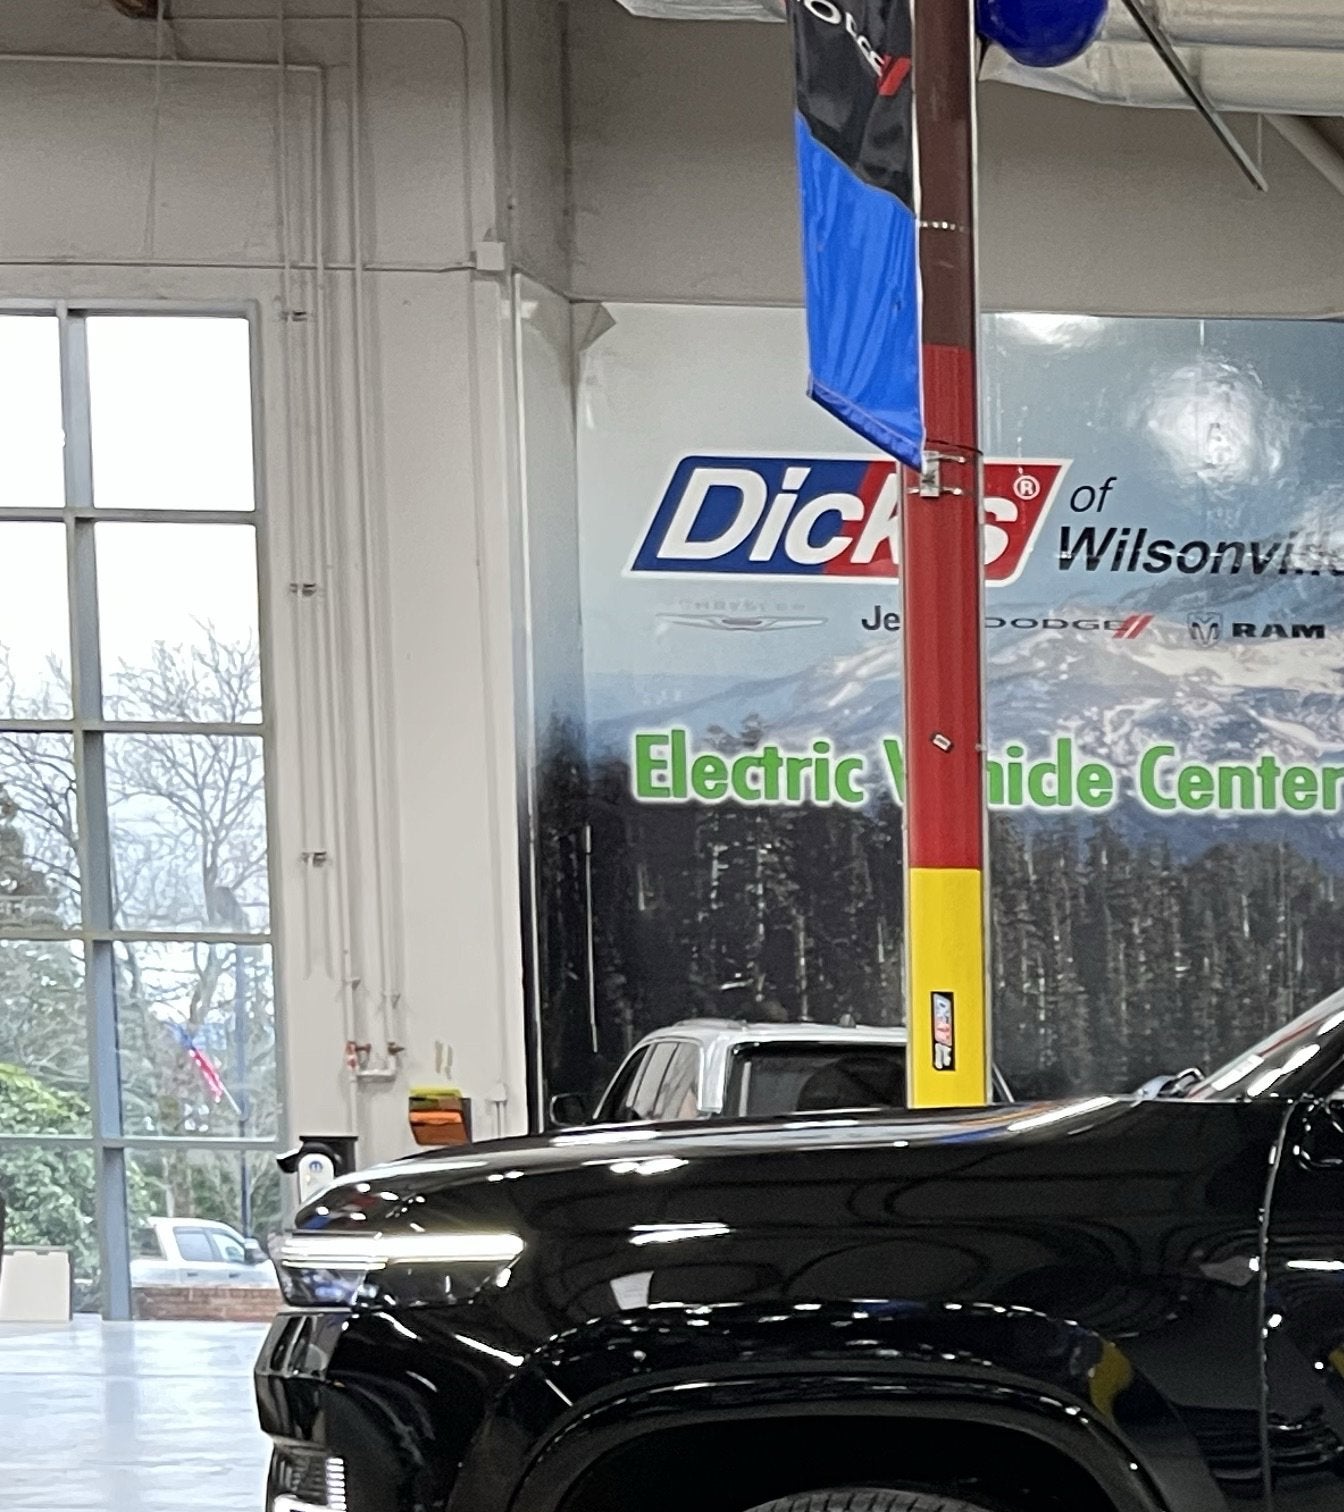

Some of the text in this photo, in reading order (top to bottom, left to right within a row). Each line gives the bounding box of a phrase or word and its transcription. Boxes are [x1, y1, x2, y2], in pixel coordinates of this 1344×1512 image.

[1069, 476, 1117, 513] of
[861, 605, 901, 631] Je
[1232, 622, 1326, 639] RAM
[635, 729, 864, 803] Electric
